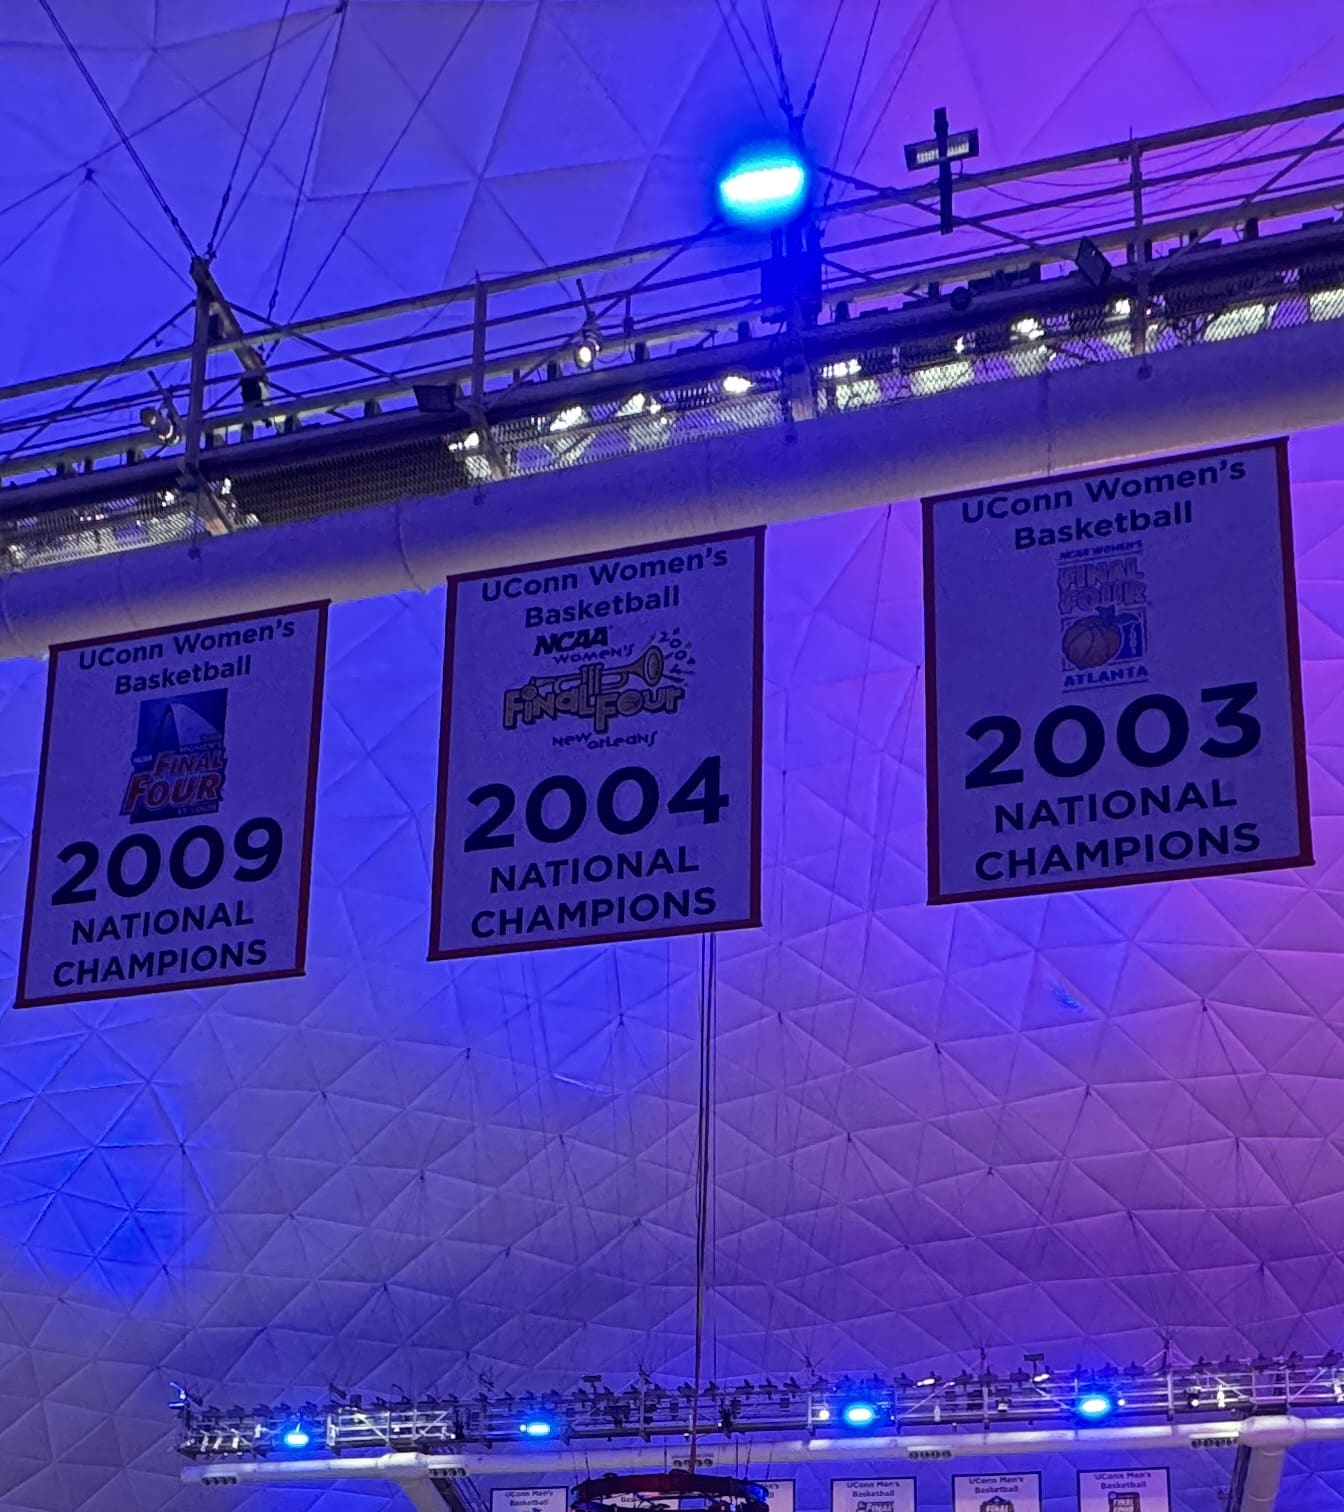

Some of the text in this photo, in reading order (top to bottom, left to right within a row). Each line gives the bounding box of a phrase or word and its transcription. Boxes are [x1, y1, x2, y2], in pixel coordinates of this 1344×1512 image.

[962, 460, 1247, 524] UConn Women's
[1015, 500, 1193, 549] Basketball
[482, 547, 729, 602] UConn Women's
[1057, 557, 1144, 588] FINAL
[525, 585, 680, 628] Basketball
[79, 619, 296, 671] UConn Women's
[533, 625, 610, 656] NCAA
[115, 656, 252, 695] Basketball
[1063, 664, 1149, 688] ATLANTA
[965, 682, 1262, 790] 2003
[153, 748, 226, 776] FINAL
[123, 771, 224, 814] FOUR
[463, 755, 730, 852] 2004
[994, 779, 1237, 834] NATIONAL
[51, 816, 284, 906] 2009
[490, 846, 699, 893] NATIONAL
[975, 823, 1260, 881] CHAMPIONS
[72, 901, 254, 945] NATIONAL
[471, 887, 717, 938] CHAMPIONS
[54, 939, 267, 987] CHAMPIONS
